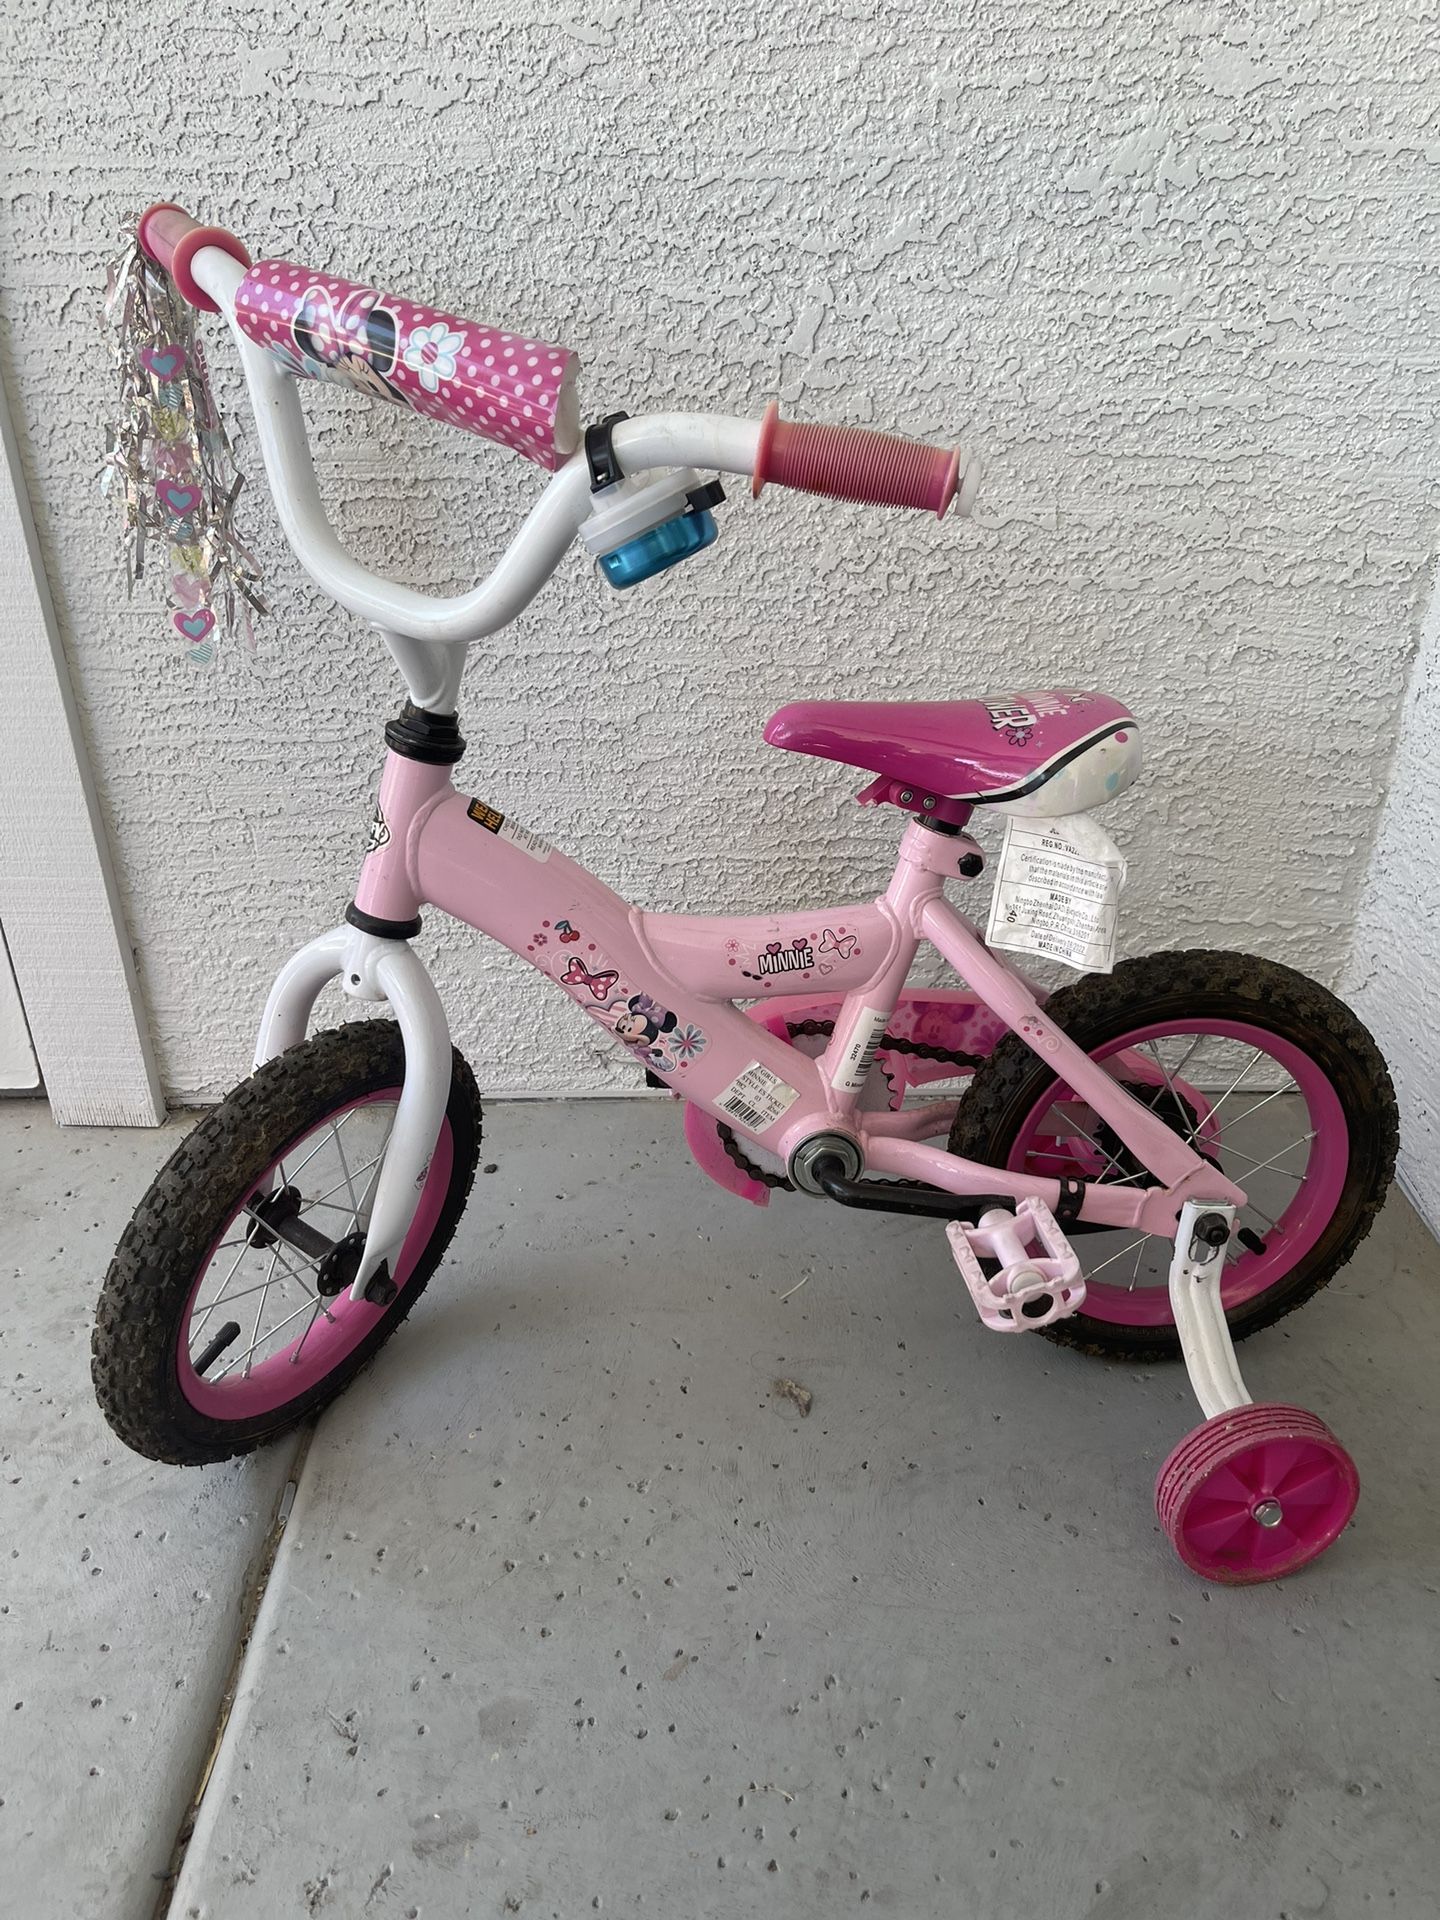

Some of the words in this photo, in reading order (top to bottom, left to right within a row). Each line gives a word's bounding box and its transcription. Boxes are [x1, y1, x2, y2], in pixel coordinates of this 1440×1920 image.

[759, 948, 815, 975] MINNIE
[850, 1043, 861, 1061] 32470
[761, 1069, 777, 1085] GIRLS
[766, 1094, 785, 1110] TICKET
